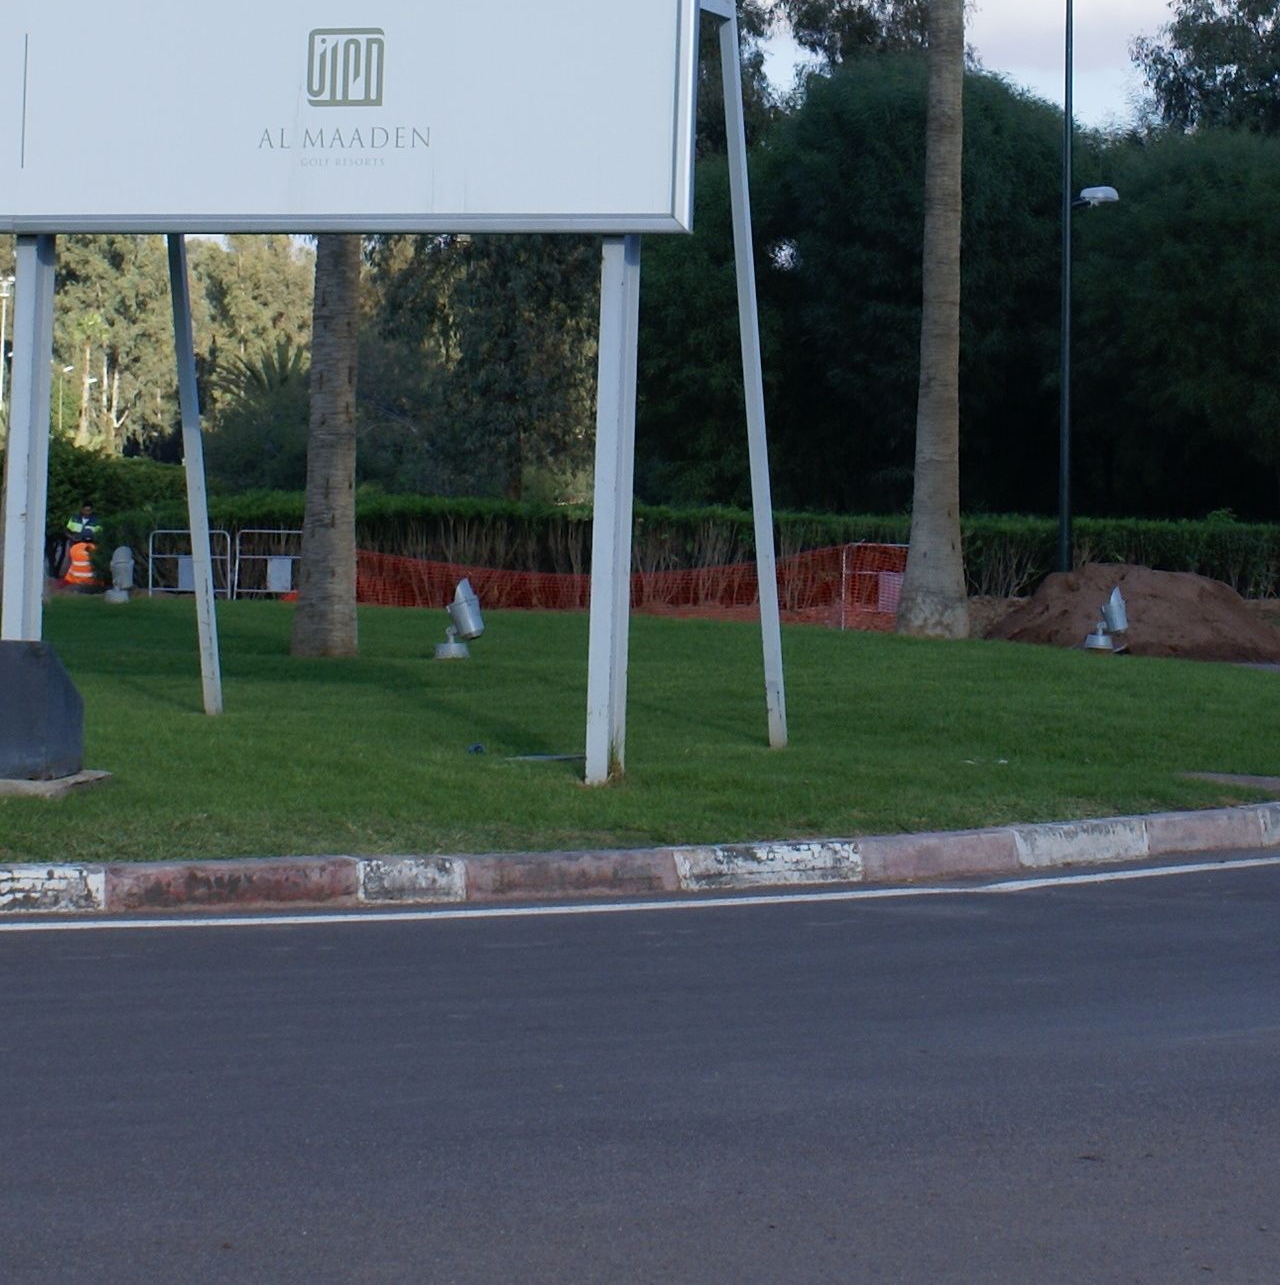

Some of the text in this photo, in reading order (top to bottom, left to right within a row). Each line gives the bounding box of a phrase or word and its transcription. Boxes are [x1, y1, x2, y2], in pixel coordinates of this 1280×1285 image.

[257, 126, 431, 149] AL MAADEN
[335, 156, 385, 167] RESORTS
